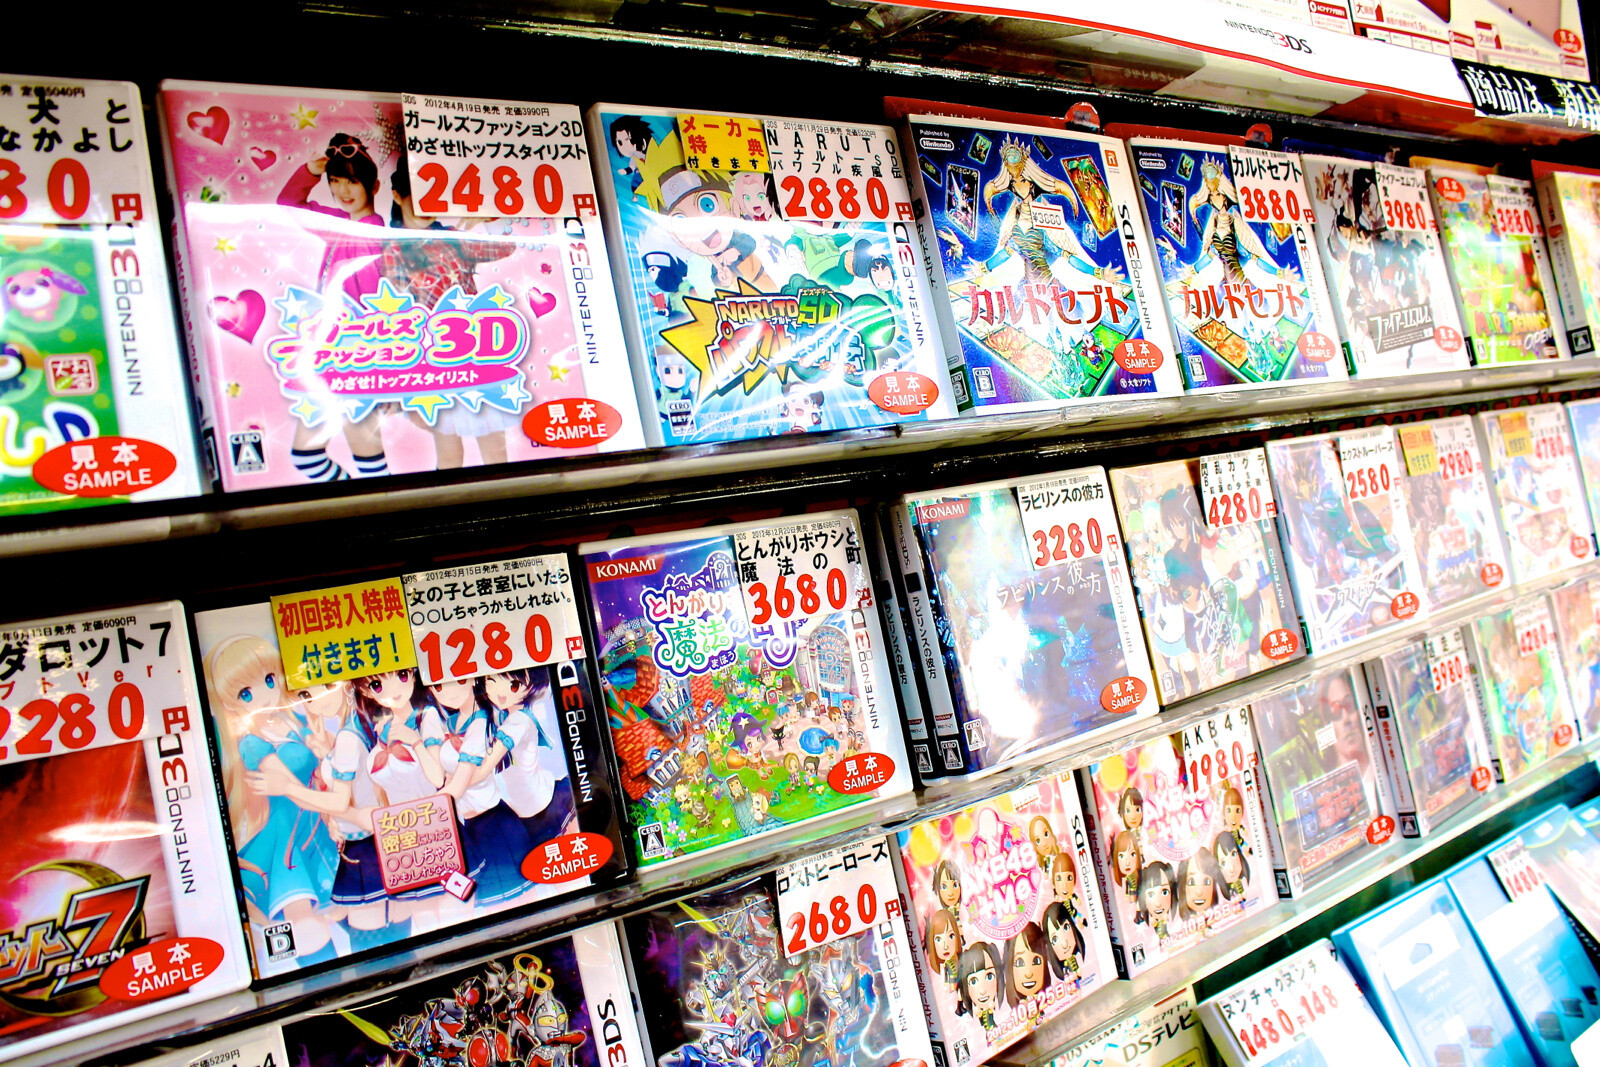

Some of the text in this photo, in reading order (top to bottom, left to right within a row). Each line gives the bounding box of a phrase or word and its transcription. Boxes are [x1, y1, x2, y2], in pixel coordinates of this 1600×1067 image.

[424, 98, 501, 115] 2012年4月19日発売
[504, 106, 550, 117] 定価3990円
[404, 110, 583, 138] ガールズファッション3D
[682, 116, 763, 139] メーカー
[407, 136, 587, 161] めざせ!トップスタイリスト
[687, 135, 765, 158] 特典
[766, 128, 896, 155] NARUTO
[687, 155, 771, 171] 付きます
[1232, 155, 1303, 183] カルドセプト
[416, 162, 564, 216] 2480
[780, 175, 890, 219] 2880
[1240, 186, 1301, 222] 3880
[1384, 200, 1427, 231] 3980
[718, 300, 799, 324] NARUTO
[961, 284, 1129, 327] カルドセプト
[1176, 283, 1305, 320] カルドセプト
[432, 316, 519, 360] 3D
[1124, 341, 1150, 357] 見本
[1306, 333, 1327, 347] 見本
[1124, 358, 1157, 370] SAMPLE
[1306, 348, 1332, 358] SAMPLE
[885, 375, 920, 393] 見本
[547, 401, 597, 425] 見本
[883, 393, 929, 408] SAMPLE
[544, 422, 608, 442] SAMPLE
[70, 441, 140, 471] 見本
[62, 467, 153, 491] SAMPLE
[1346, 463, 1390, 500] 2580
[1021, 482, 1105, 512] ラビリンスの彼方
[1208, 487, 1262, 528] 4280
[920, 503, 965, 523] KONAMI
[737, 526, 861, 561] とんがりボウシと
[1032, 517, 1104, 567] 3280
[425, 562, 500, 582] 2012年3月15日発売
[596, 557, 658, 579] KONAMI
[406, 566, 571, 608] 女の子と密室にいたら
[748, 567, 848, 626] 3680
[277, 585, 406, 639] 初回封入特典
[418, 613, 553, 684] 1280
[1269, 630, 1289, 648] 見本
[1269, 643, 1294, 657] SAMPLE
[710, 650, 736, 670] まほう
[1110, 678, 1135, 698] 見本
[1110, 693, 1142, 712] SAMPLE
[844, 755, 879, 777] 見本
[1189, 740, 1245, 793] 1980
[842, 771, 886, 791] SAMPLE
[377, 801, 449, 836] 女の子と
[381, 827, 453, 856] 密室にいたら
[544, 836, 589, 865] 見本
[388, 861, 460, 887] かもしれない
[541, 853, 600, 881] SAMPLE
[960, 841, 1038, 904] AKB48
[785, 883, 878, 955] 2680
[54, 947, 126, 977] SEVEN
[131, 942, 192, 978] 見本
[126, 962, 205, 998] SAMPLE
[1222, 977, 1284, 1020] ヌンチャク
[1239, 1008, 1295, 1057] 1480
